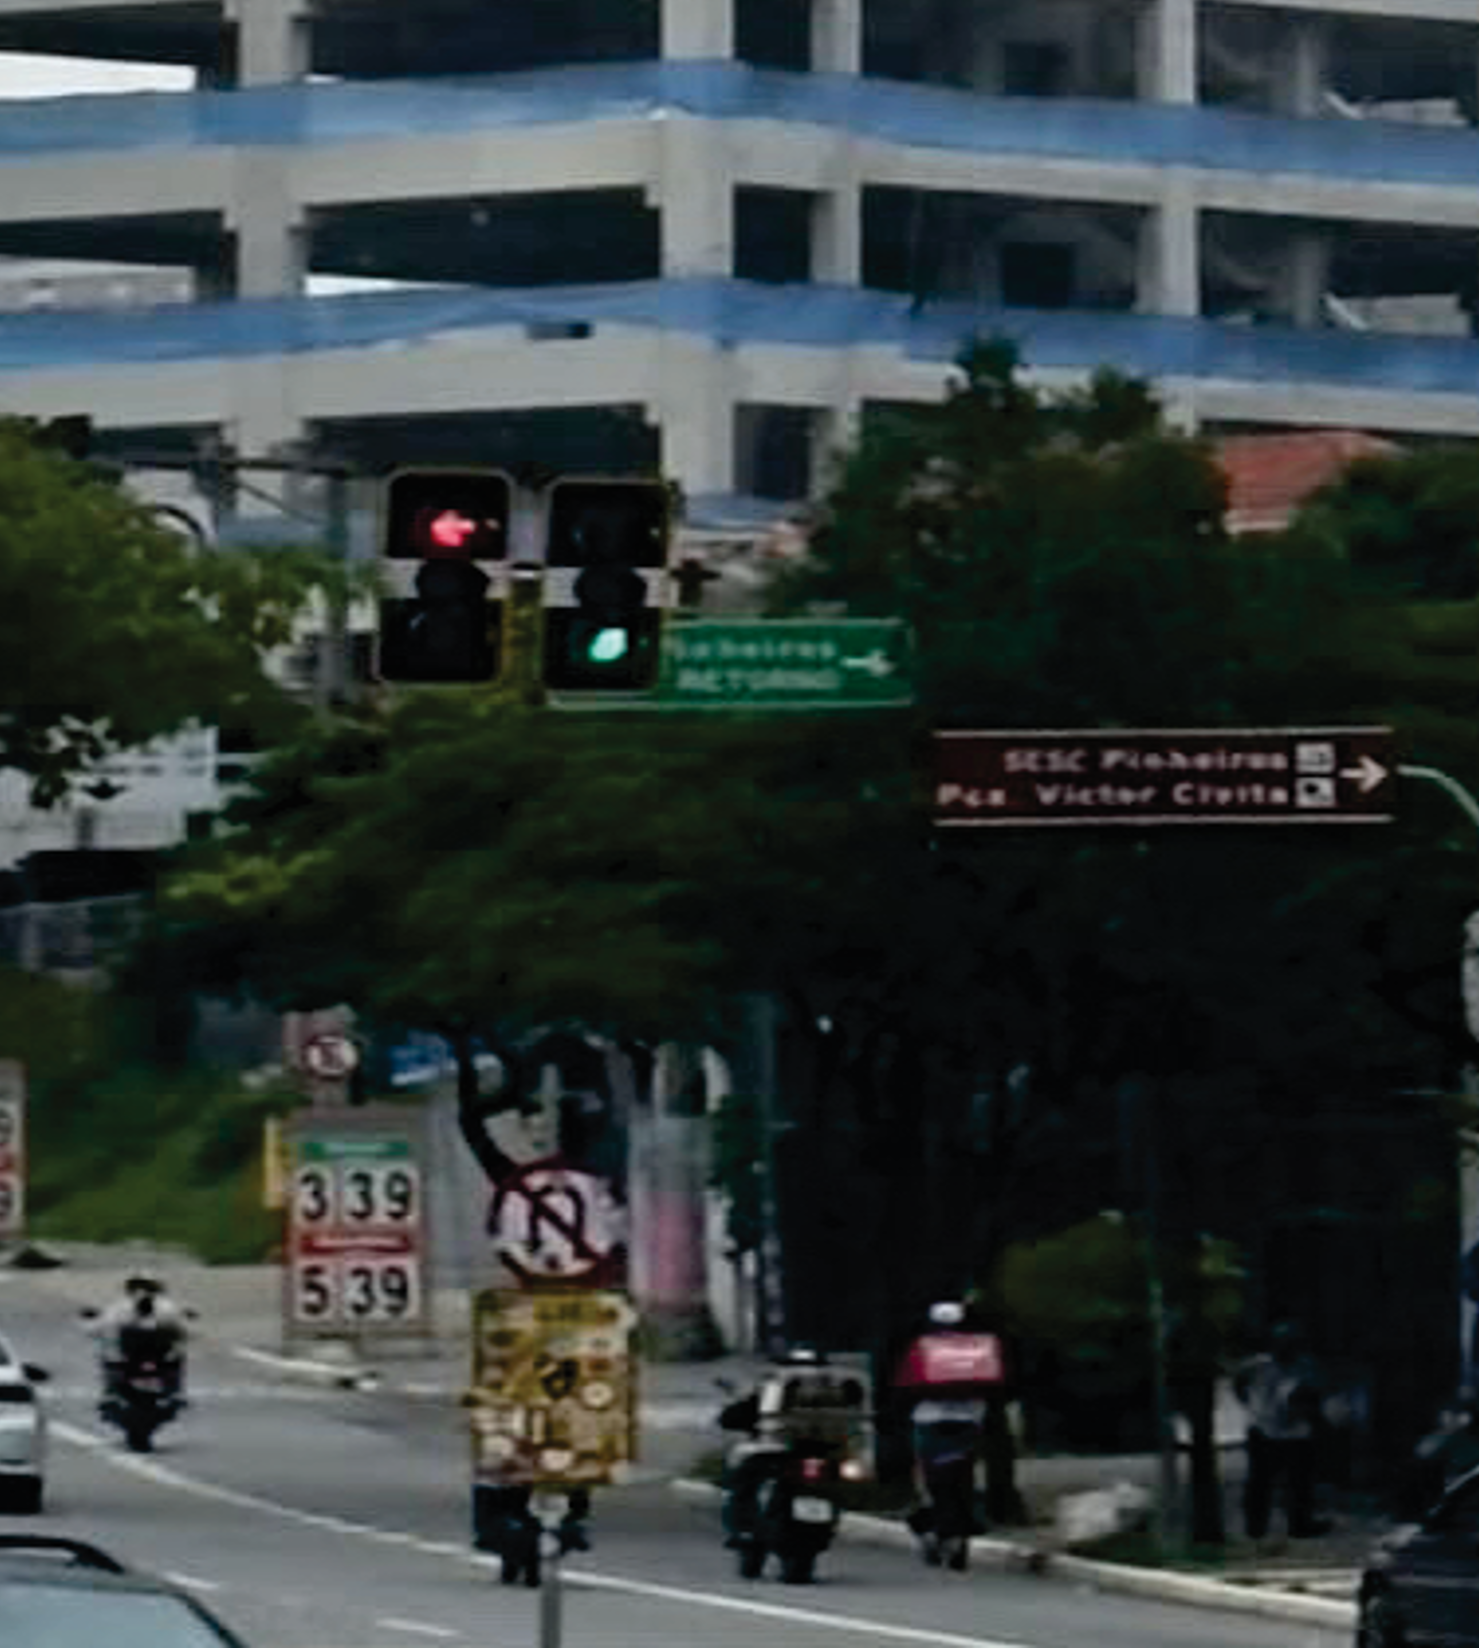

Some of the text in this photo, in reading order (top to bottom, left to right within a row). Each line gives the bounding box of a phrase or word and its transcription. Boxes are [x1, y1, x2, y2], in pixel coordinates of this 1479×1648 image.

[1003, 749, 1289, 772] SESC Pinheiros
[1034, 783, 1159, 806] Victor
[1173, 782, 1289, 806] Civita
